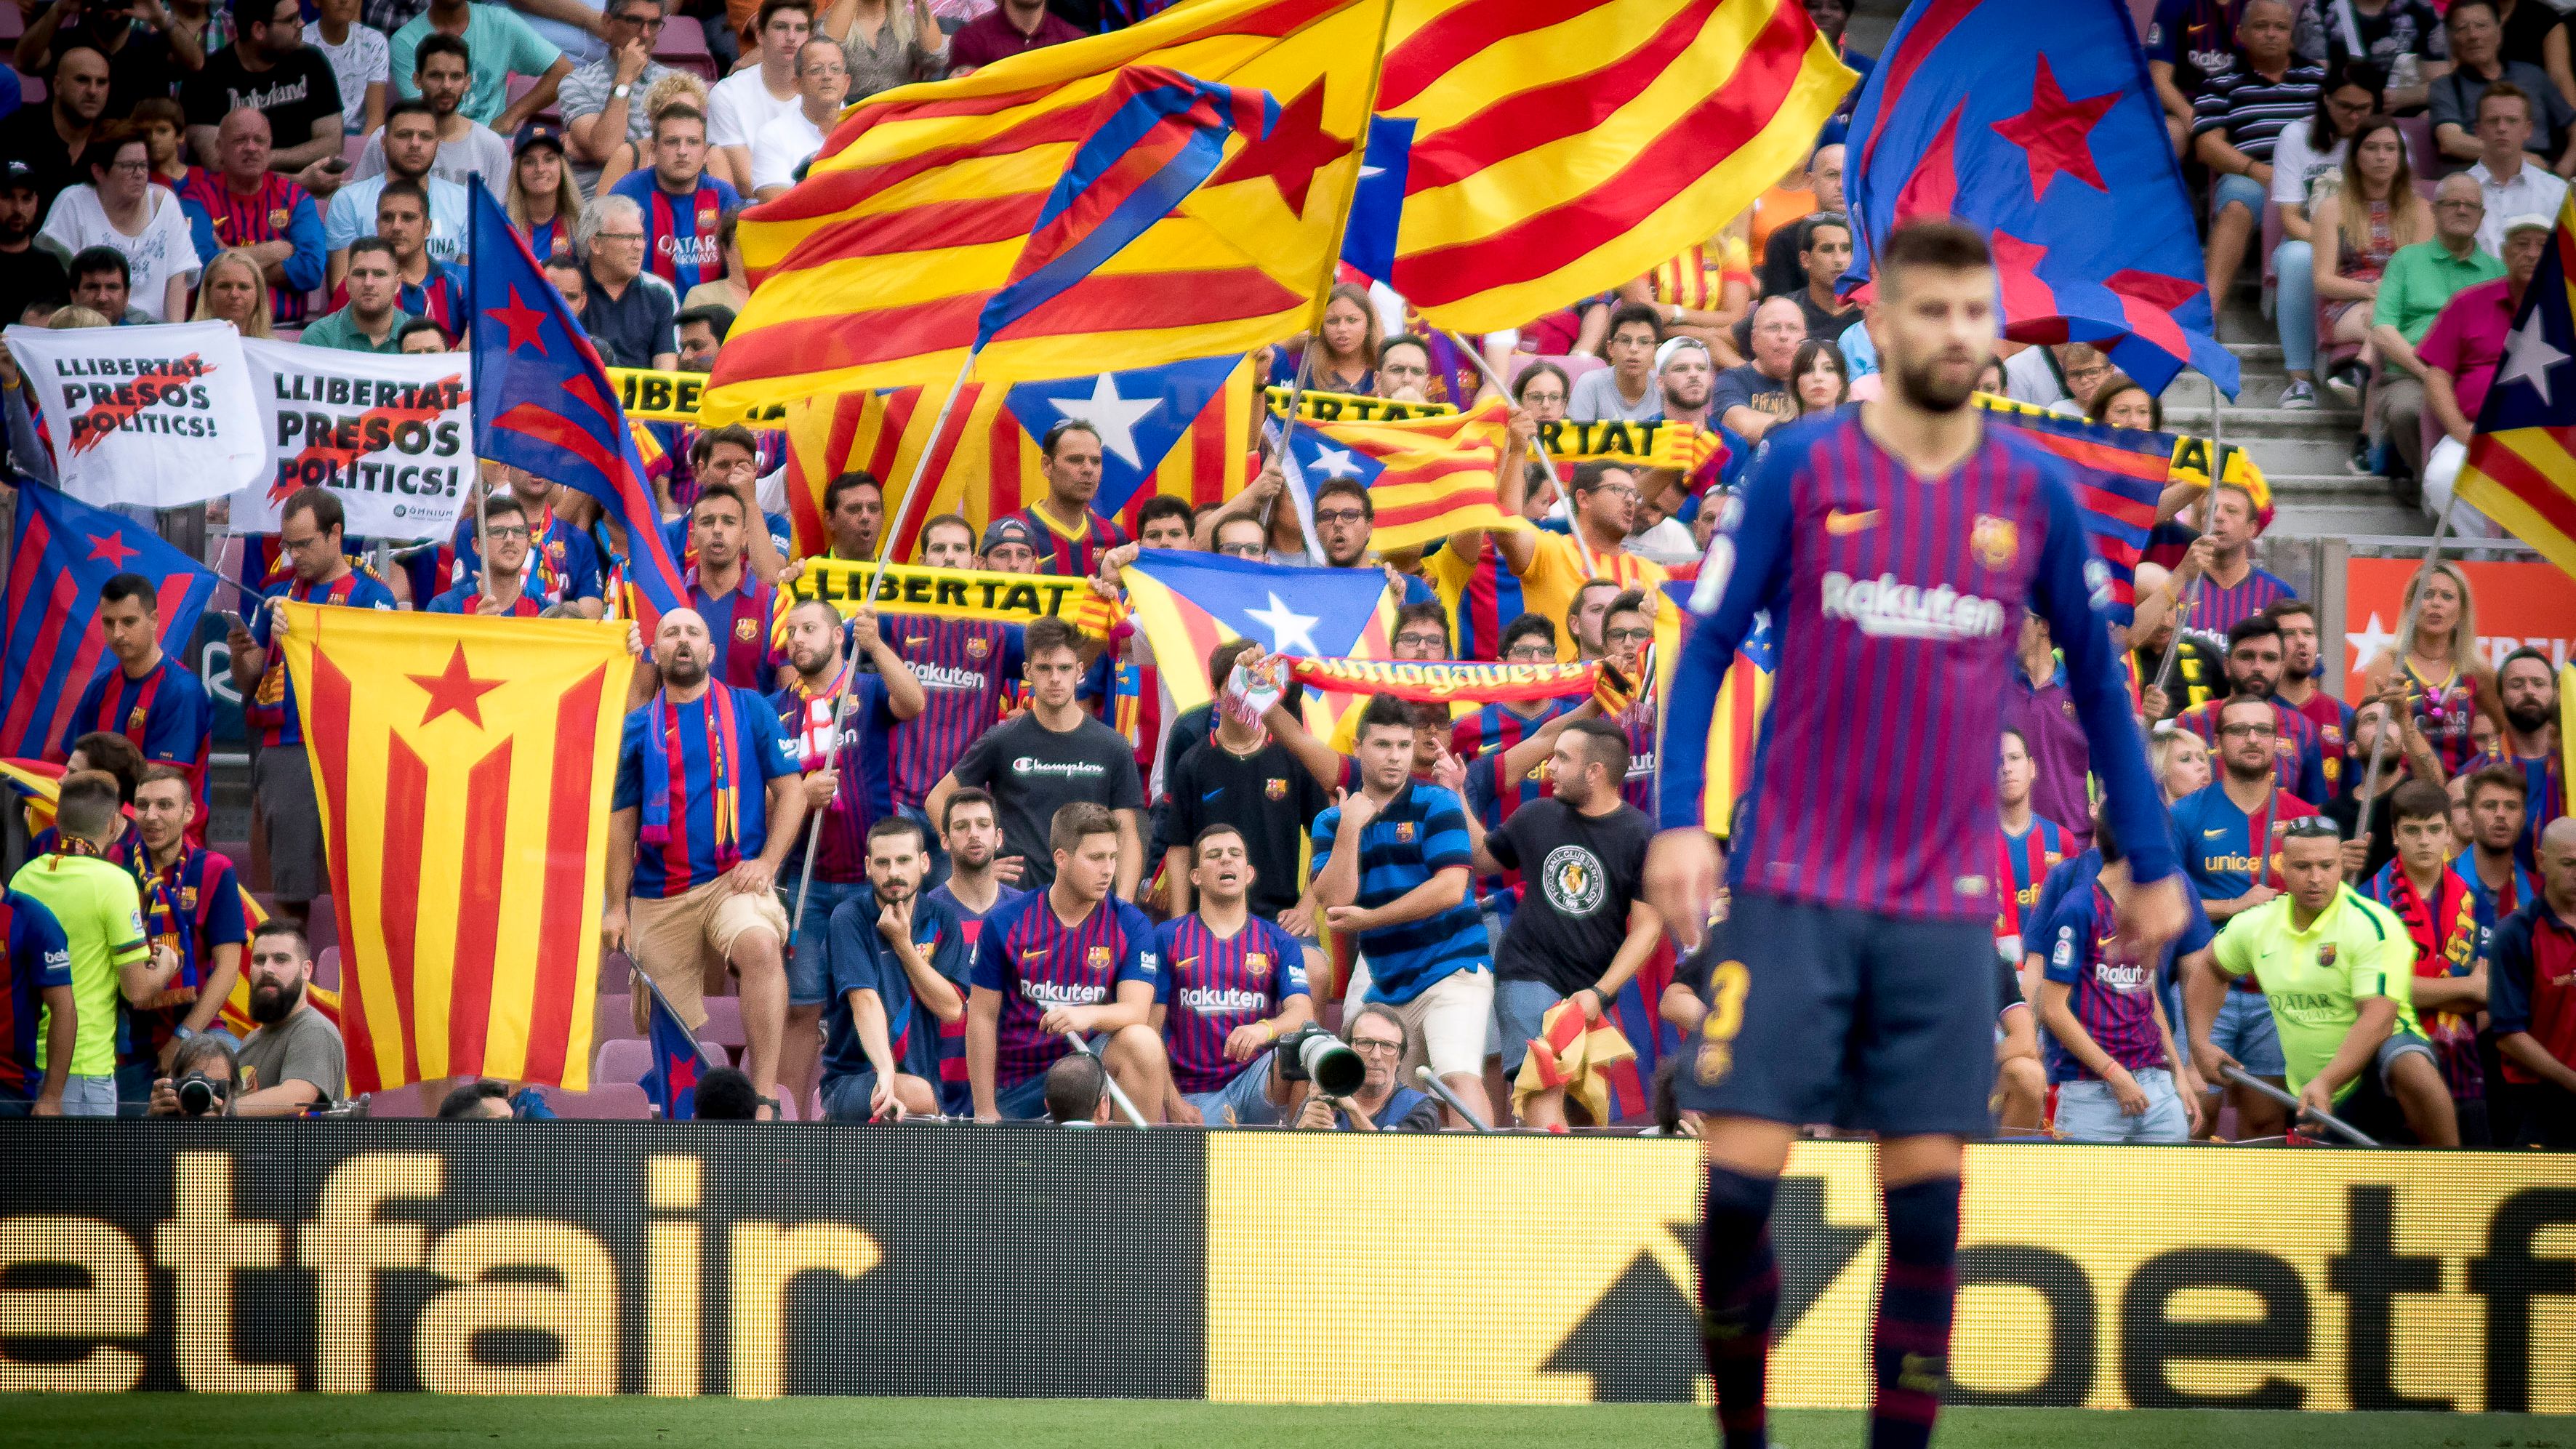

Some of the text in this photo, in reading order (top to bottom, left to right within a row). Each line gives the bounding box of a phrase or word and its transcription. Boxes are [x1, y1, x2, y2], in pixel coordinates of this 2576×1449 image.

[657, 235, 717, 255] QATAR
[55, 358, 204, 377] LLIBERTAT
[62, 382, 211, 410] PRESOS
[273, 372, 463, 409] LLIBERTAT
[70, 408, 217, 439] POLÍTICS!
[277, 409, 460, 457] PRESOS
[277, 451, 458, 497] POLÍTICS!
[787, 568, 1074, 617] LLIBERTAT
[1821, 571, 2005, 637] Rakuten
[1012, 757, 1104, 776] Champion
[2205, 851, 2263, 871] unice
[1020, 979, 1107, 1002] Rakuten
[1180, 986, 1264, 1008] Rakuten
[1703, 960, 1752, 1041] 3
